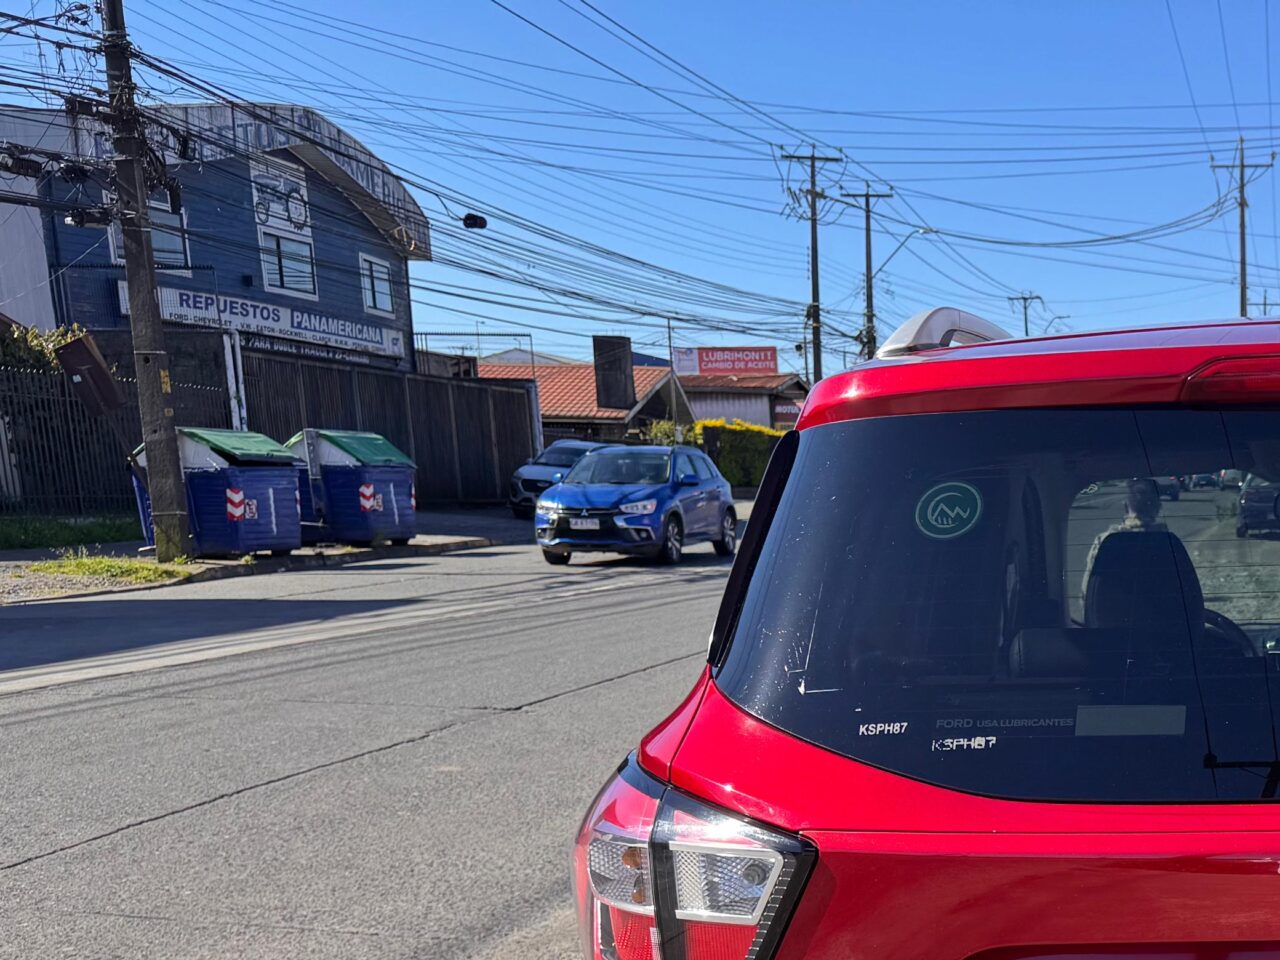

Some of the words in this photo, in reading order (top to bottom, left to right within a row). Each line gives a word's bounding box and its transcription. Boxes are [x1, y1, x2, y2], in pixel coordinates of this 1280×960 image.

[179, 292, 281, 322] REPUESTOS
[293, 311, 382, 343] PANAMERICANA
[701, 361, 733, 369] CAMBIO
[735, 361, 746, 369] DE
[747, 361, 775, 369] ACEITE
[858, 722, 908, 735] KSPH87
[936, 719, 973, 729] FORD
[976, 719, 999, 728] USA
[1000, 718, 1074, 728] LUBRICANTES
